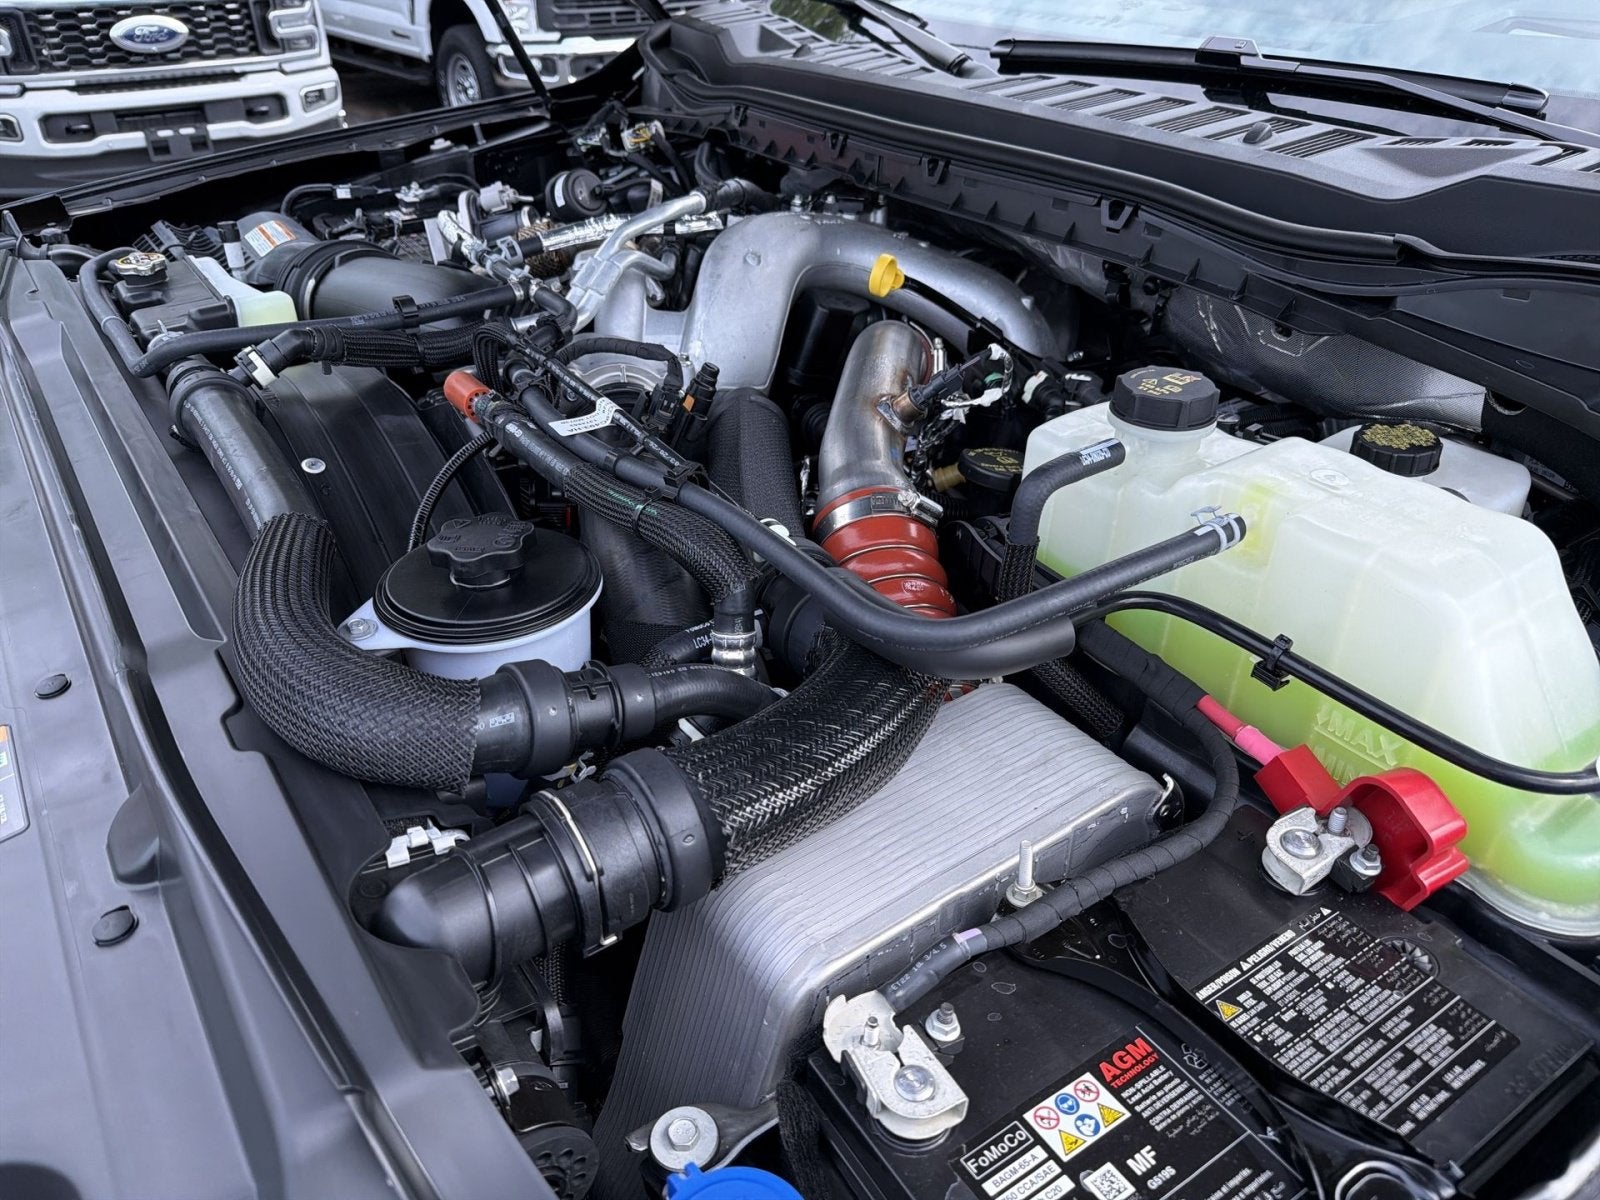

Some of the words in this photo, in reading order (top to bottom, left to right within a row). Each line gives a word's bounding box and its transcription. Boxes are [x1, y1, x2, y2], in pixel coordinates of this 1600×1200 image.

[133, 25, 169, 42] Ford
[1327, 709, 1405, 766] MAX
[1195, 967, 1241, 1001] ANGER/POISON
[1099, 1037, 1153, 1082] AGM
[1111, 1052, 1159, 1088] TECHNOLOGY
[1121, 1065, 1166, 1099] NON-SPILLABLE
[1126, 1092, 1142, 1105] Lead
[967, 1130, 1026, 1174] FoMoCo
[1126, 1145, 1157, 1176] MF
[992, 1153, 1039, 1188] BAGM-65-A
[1017, 1165, 1056, 1195] CCA/SAE
[1147, 1165, 1177, 1190] G519S
[1045, 1185, 1063, 1200] C20
